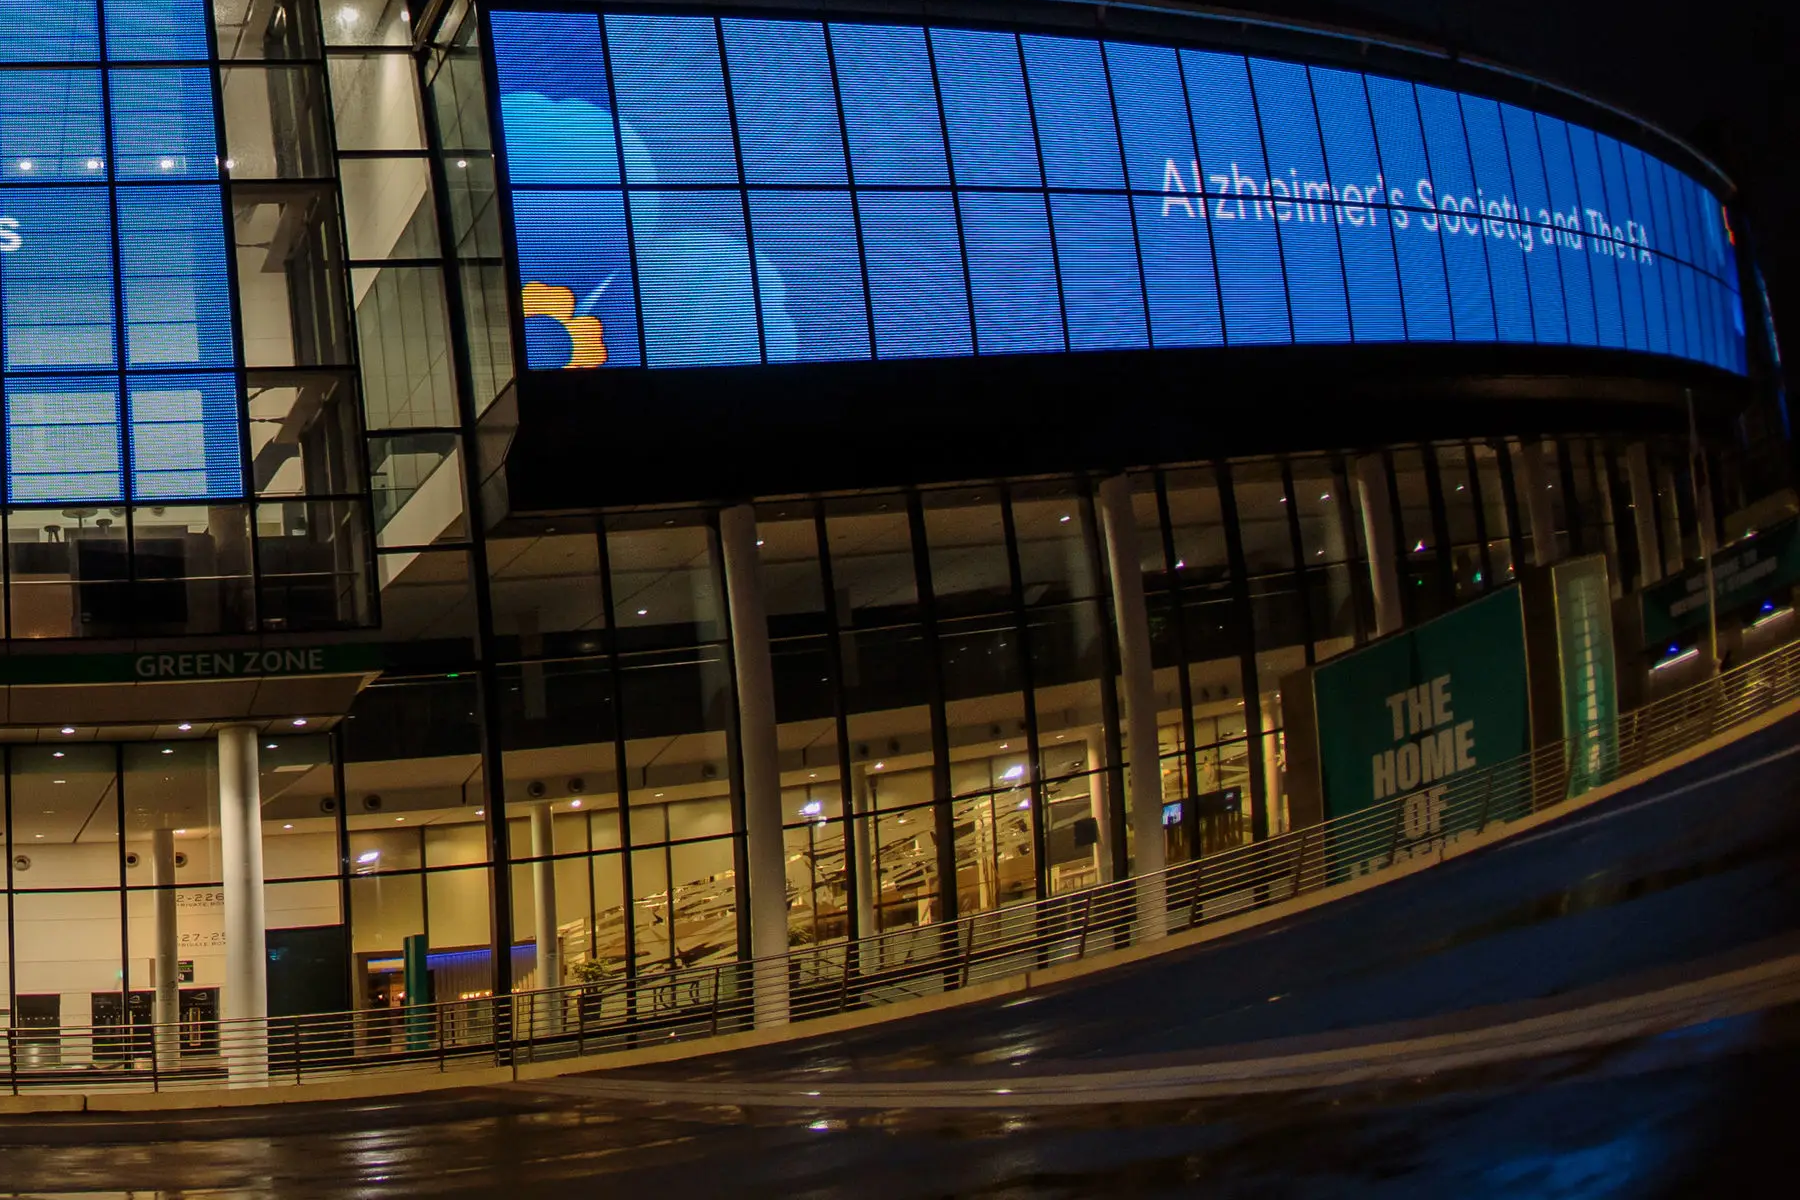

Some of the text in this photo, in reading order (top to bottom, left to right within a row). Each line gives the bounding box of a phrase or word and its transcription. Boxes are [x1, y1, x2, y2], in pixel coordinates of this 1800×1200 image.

[1161, 158, 1409, 229] Alzheimer's
[1416, 178, 1534, 253] Society
[1538, 205, 1583, 250] and
[135, 648, 325, 678] GREEN ZONE
[1385, 673, 1454, 742] THE
[1371, 719, 1477, 801] HOME
[1403, 783, 1450, 841] OF
